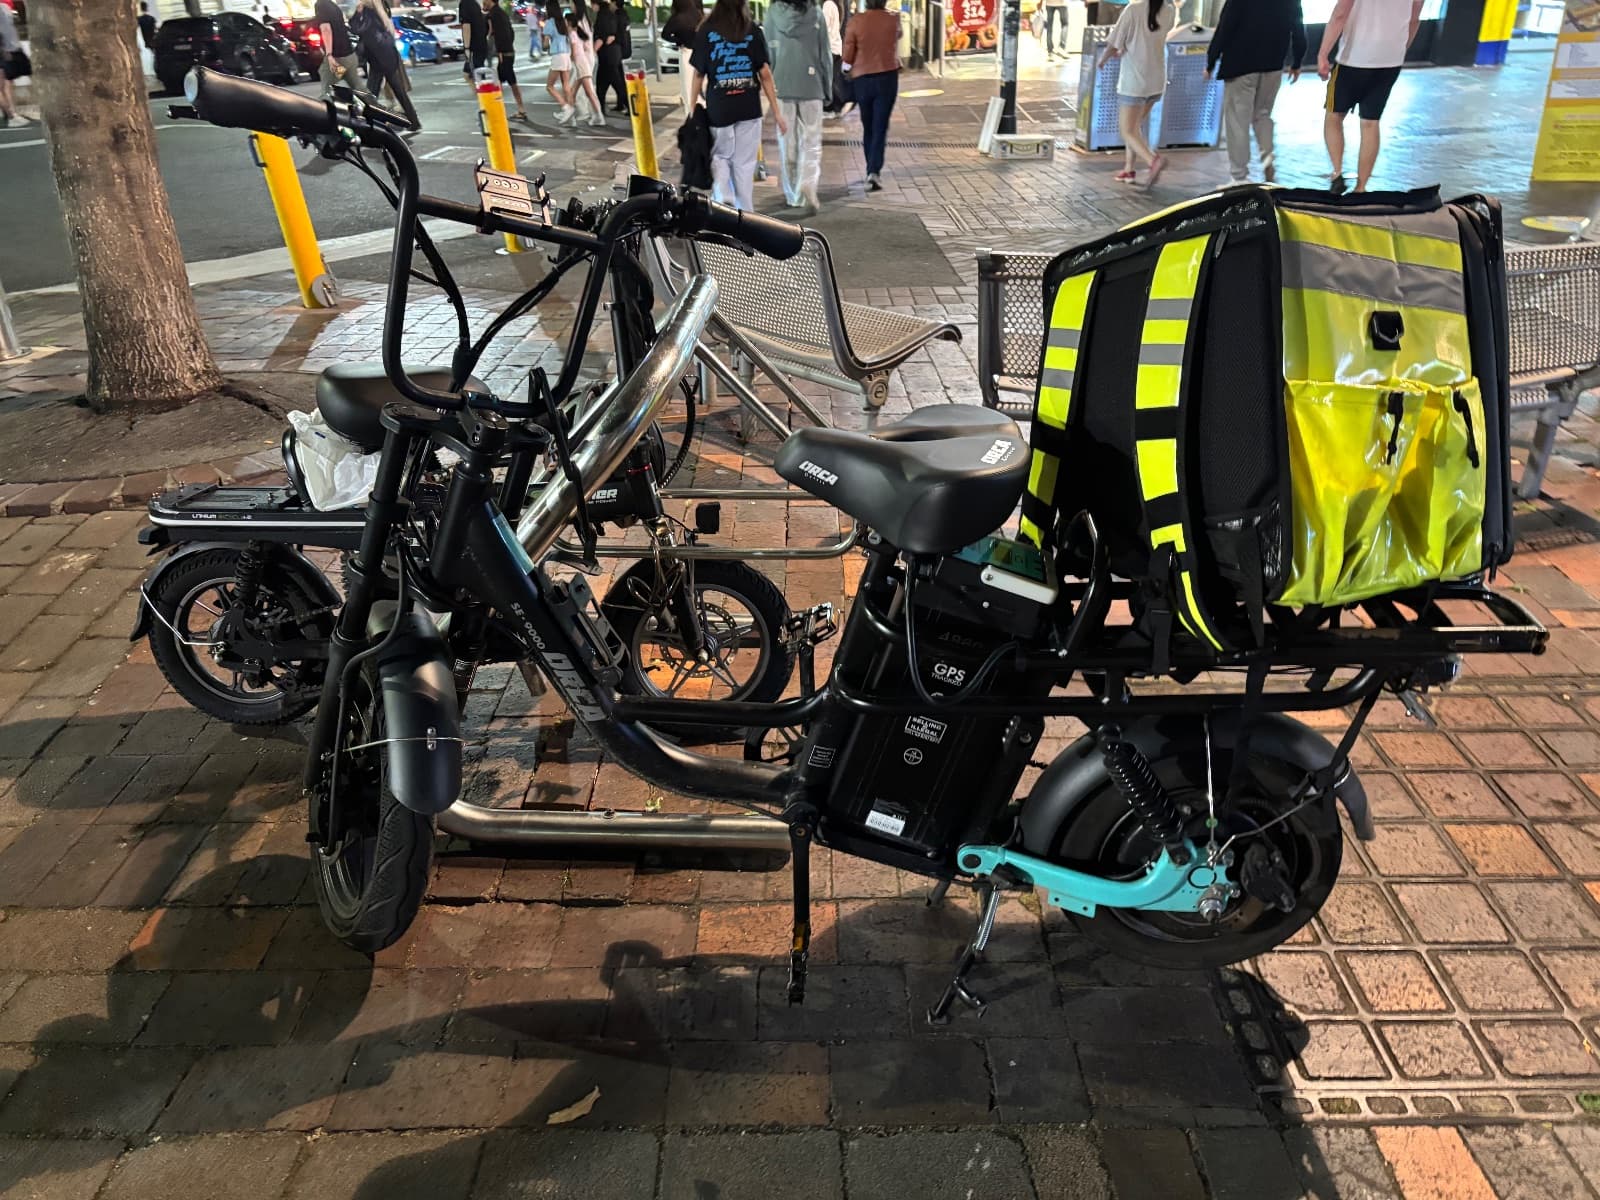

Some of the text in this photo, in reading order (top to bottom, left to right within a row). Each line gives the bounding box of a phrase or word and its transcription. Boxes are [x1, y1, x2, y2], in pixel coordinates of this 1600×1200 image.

[799, 460, 839, 486] ORCA
[934, 663, 966, 682] GPS
[541, 651, 608, 722] ORCA
